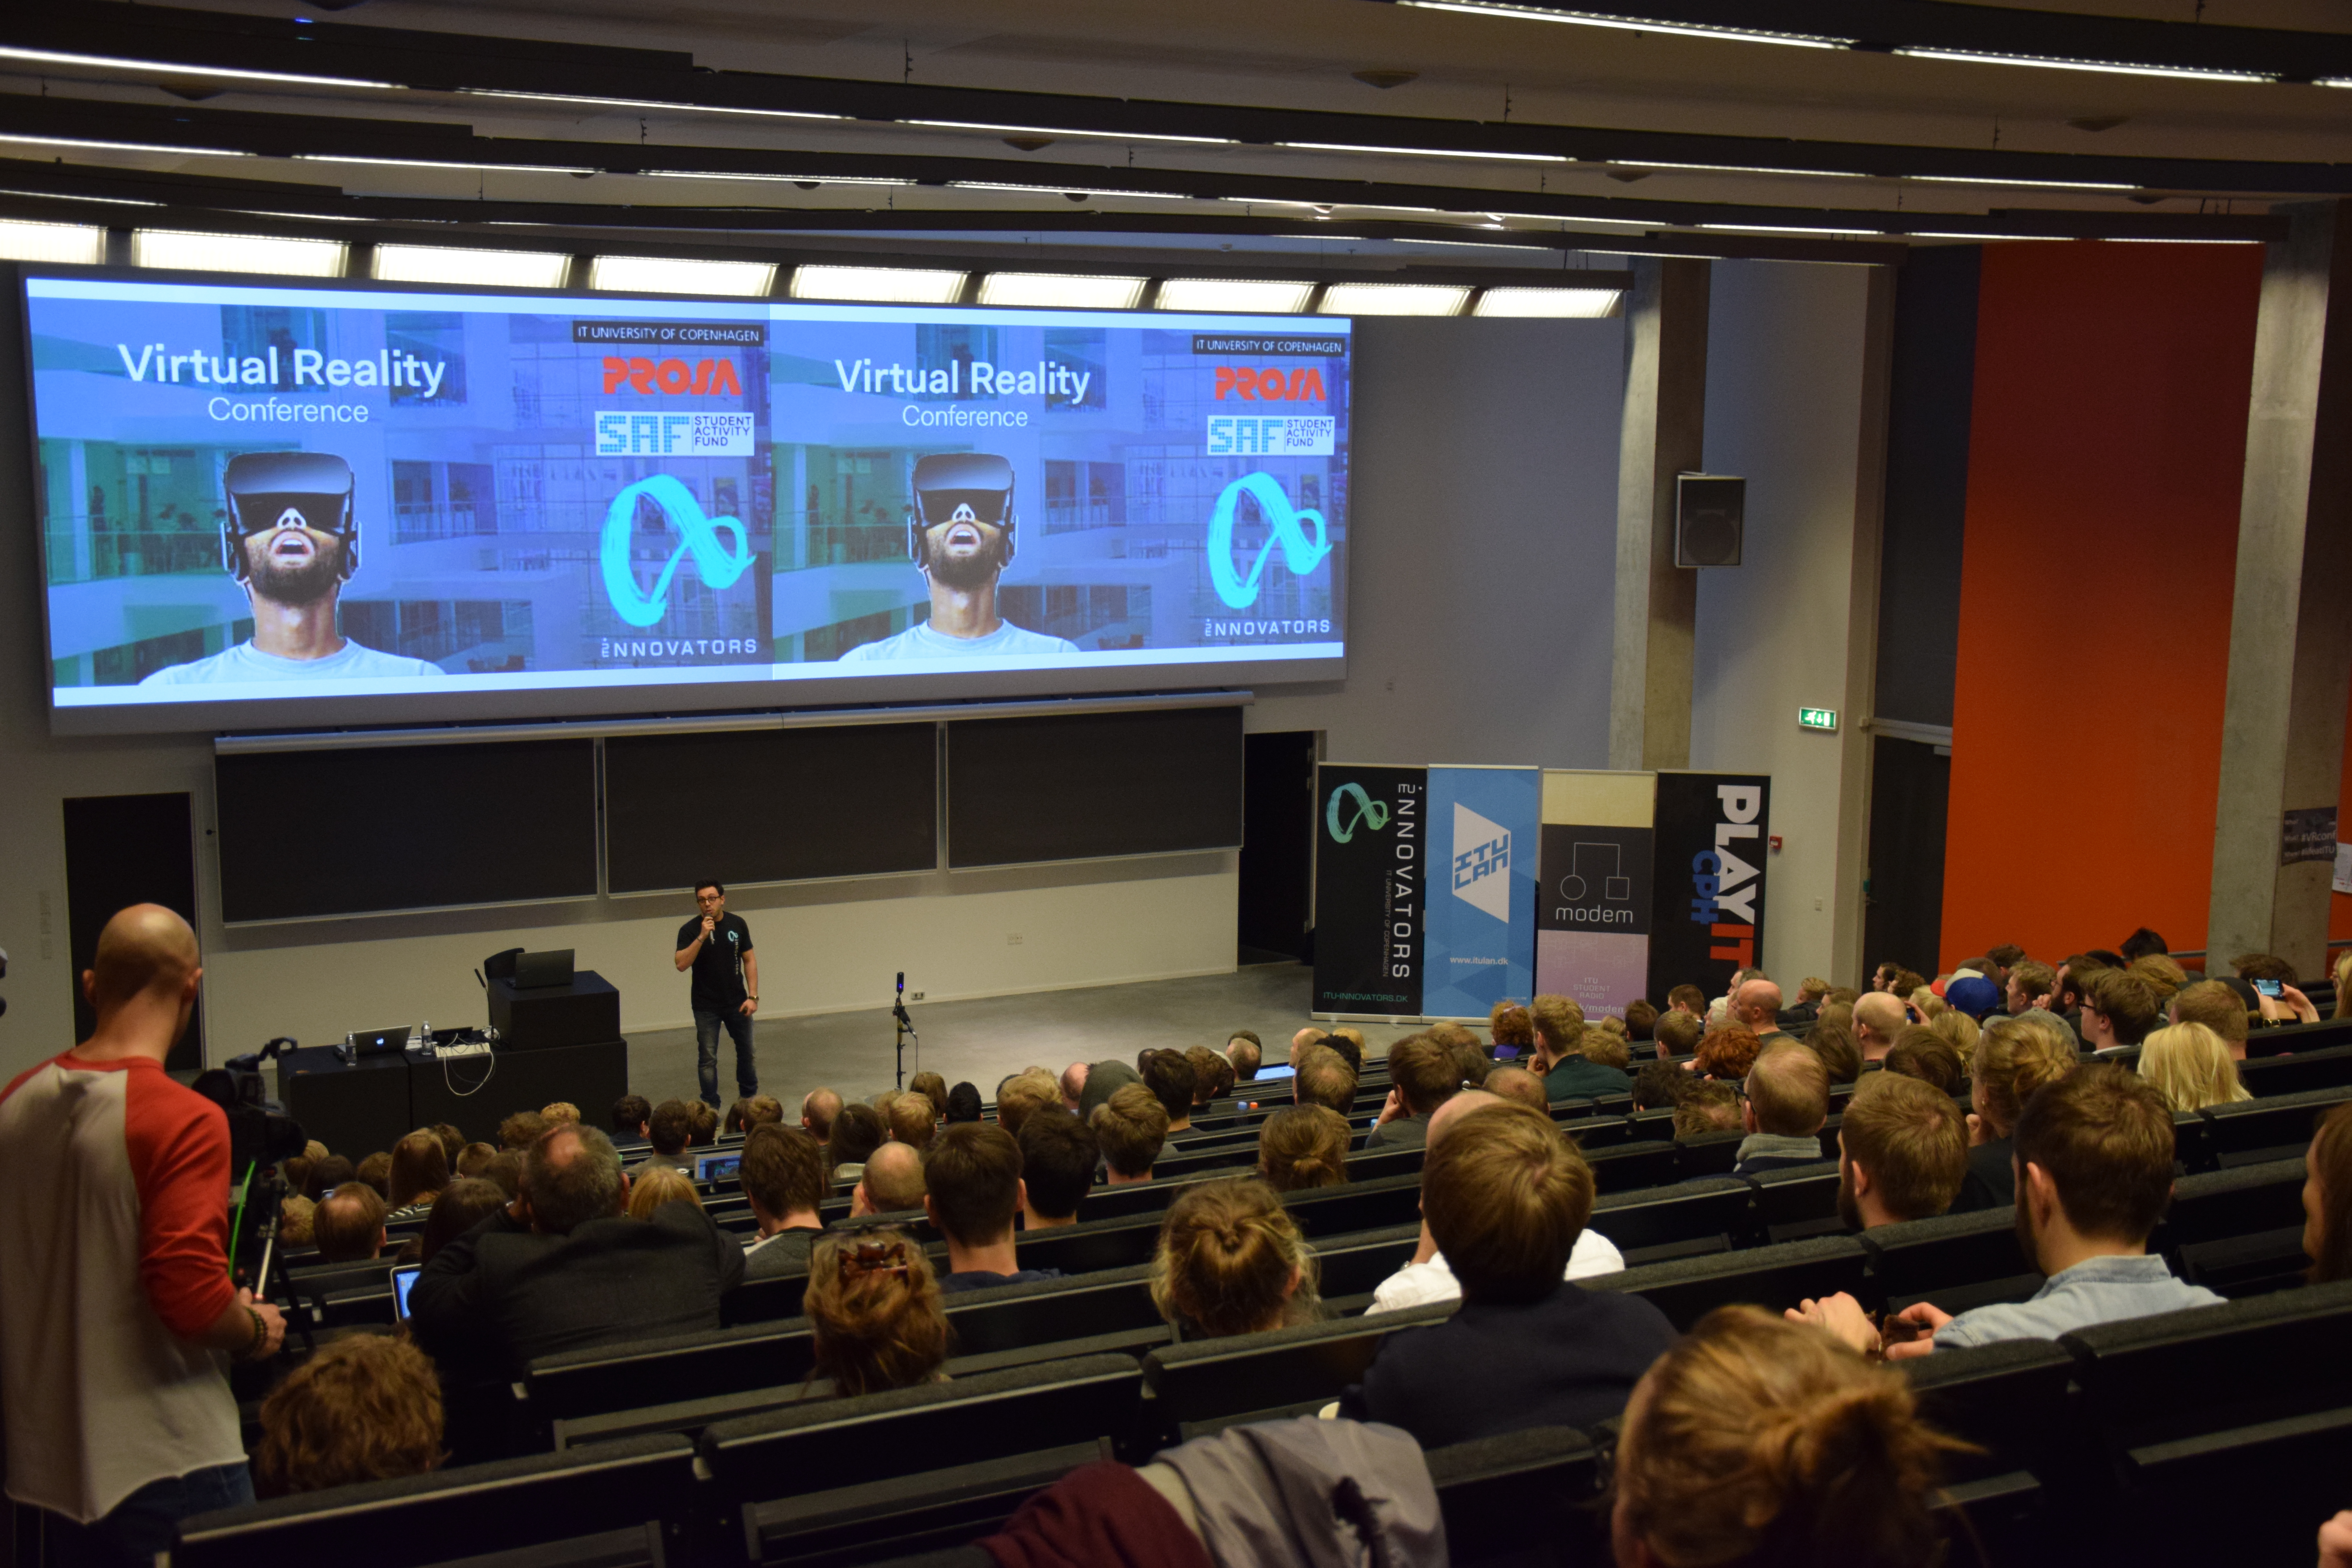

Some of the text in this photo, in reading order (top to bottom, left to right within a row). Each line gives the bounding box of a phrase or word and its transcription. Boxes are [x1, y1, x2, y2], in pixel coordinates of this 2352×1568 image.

[578, 327, 759, 341] IT UNIVERSITY OF COPENHAGEN
[1197, 340, 1341, 352] IT UNIVERSITY OF COPENHAGEN
[117, 343, 446, 397] Virtual Reality
[602, 357, 742, 396] PROSA
[835, 359, 1090, 404] Virtual Reality
[1216, 367, 1327, 401] PROSA
[208, 397, 369, 422] Conference
[902, 405, 1028, 426] Conference
[695, 416, 751, 426] STUDENT
[695, 426, 751, 436] ACTIVITY
[599, 415, 690, 453] SAF
[695, 437, 729, 446] FUND
[1211, 419, 1283, 452] SAF
[1287, 438, 1314, 446] FUND
[1455, 833, 1508, 873] ITU
[1455, 851, 1508, 890] LAN
[1711, 785, 1760, 968] PLAY IT
[1384, 920, 1390, 928] OF
[1556, 905, 1633, 923] modem
[1450, 957, 1508, 965] www.itulan.dk
[1323, 992, 1408, 1002] ITU-INNOVATORS.DK
